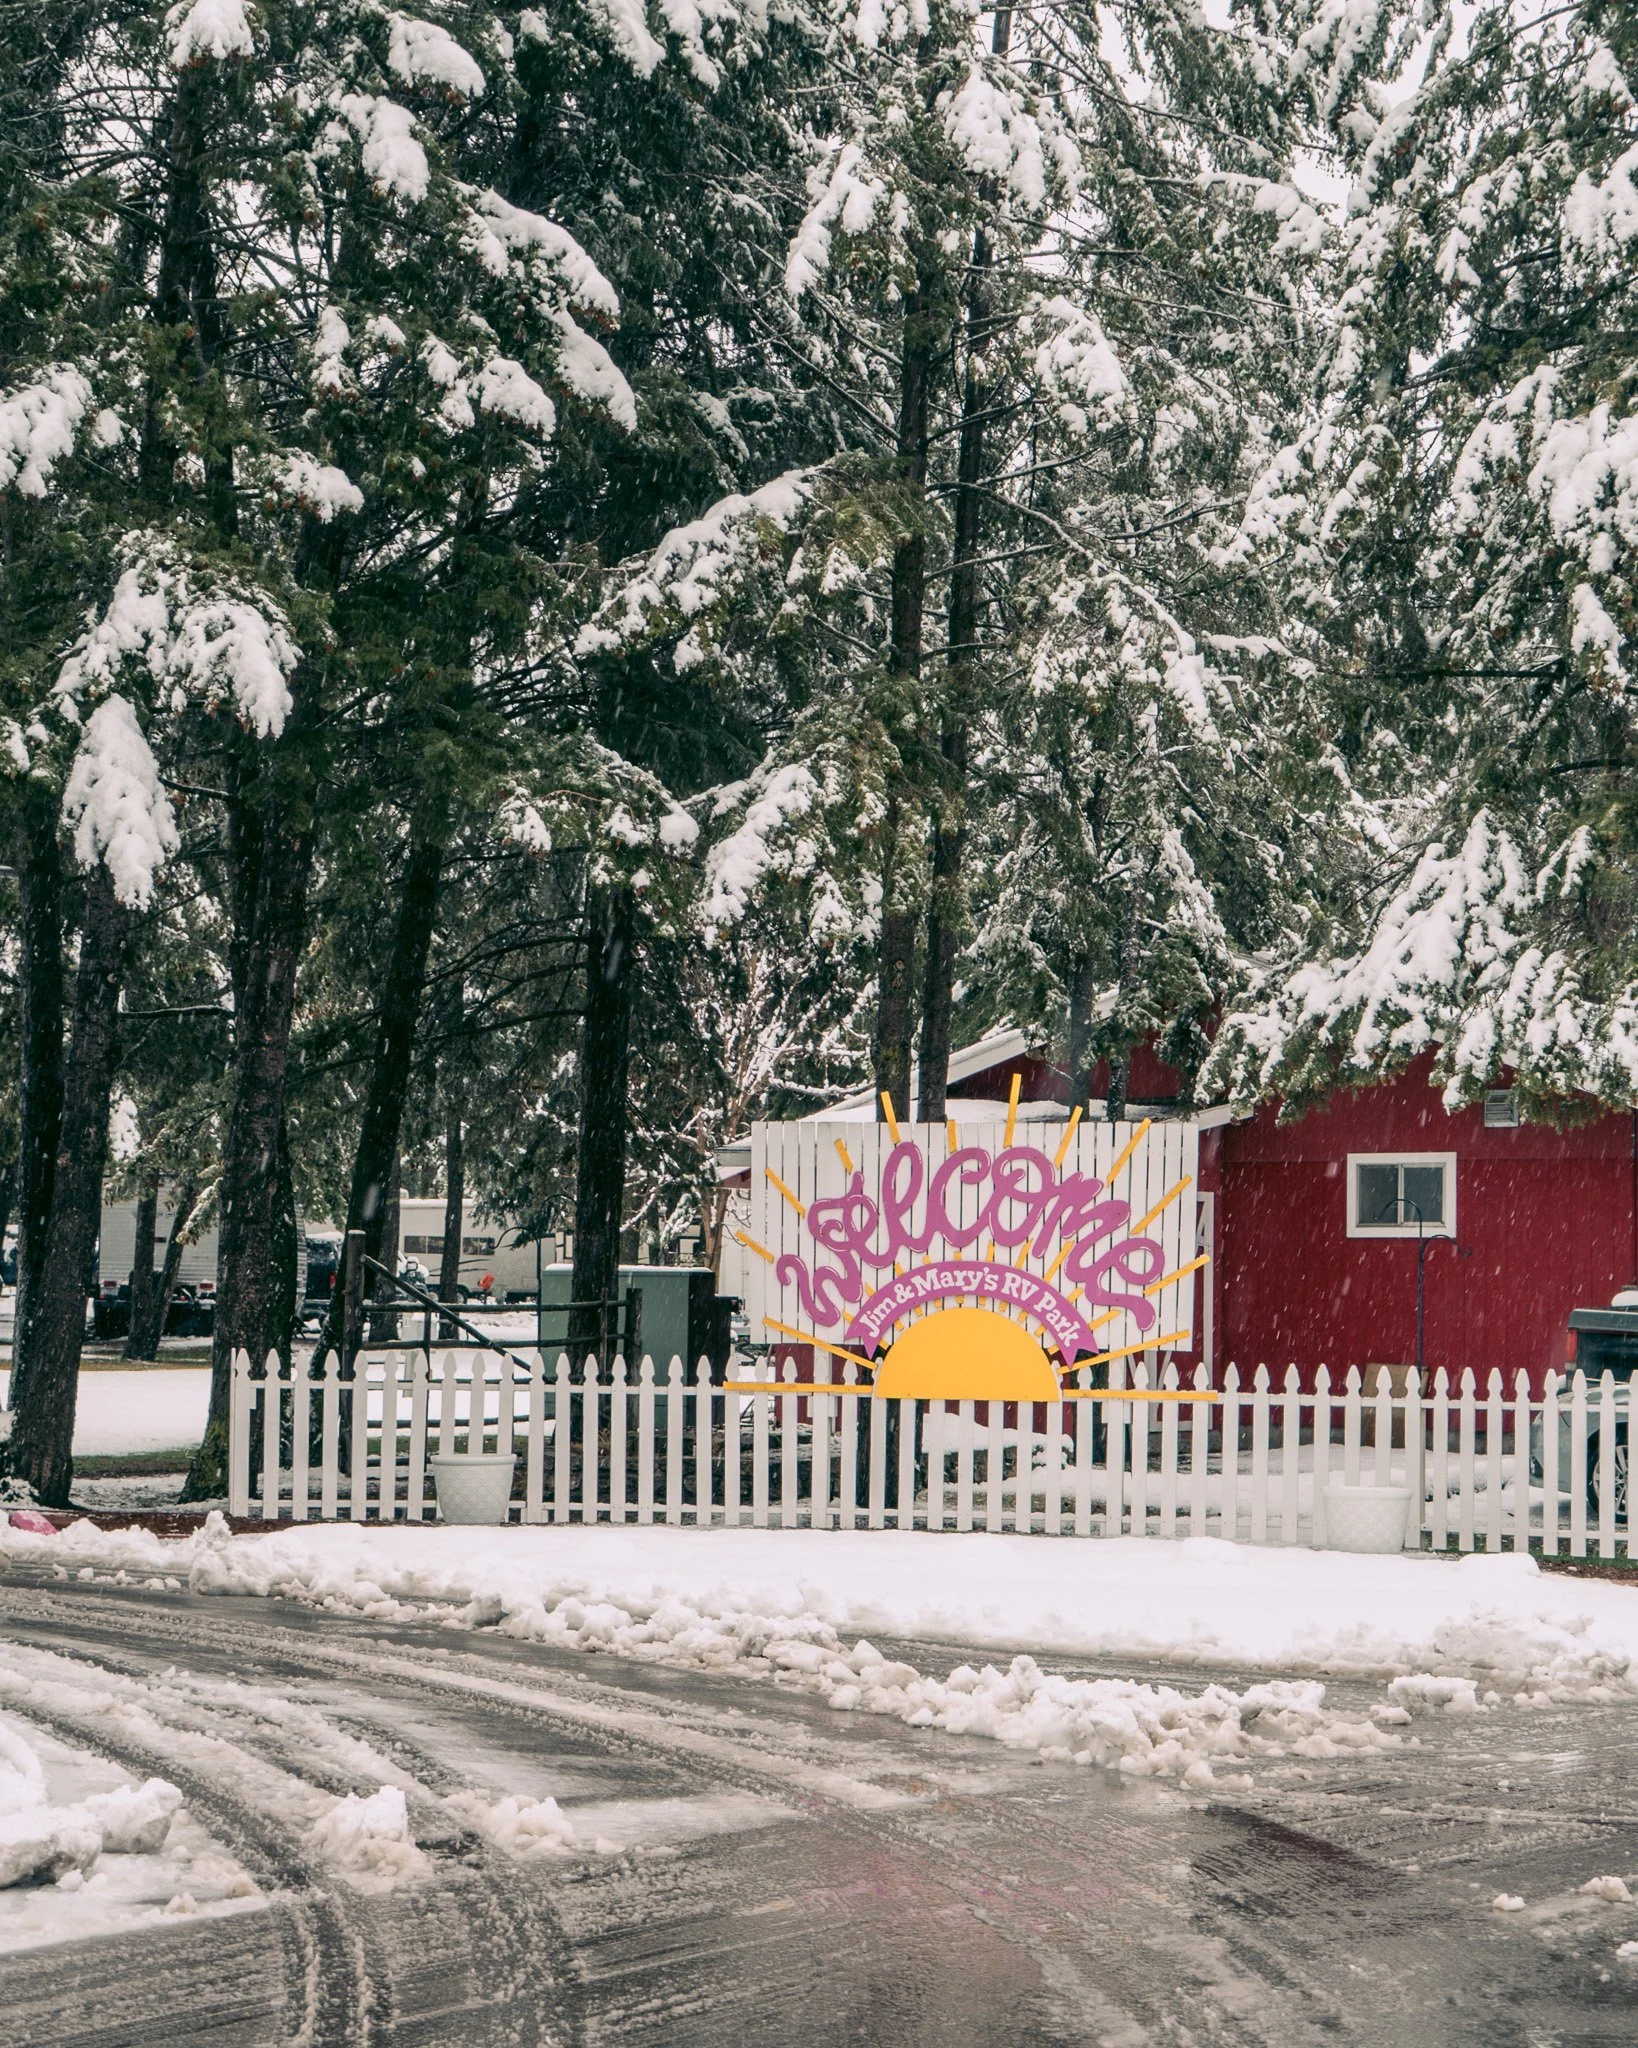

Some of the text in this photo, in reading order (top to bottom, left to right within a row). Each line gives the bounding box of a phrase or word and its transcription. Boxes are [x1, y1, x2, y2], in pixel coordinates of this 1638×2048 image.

[859, 1266, 1081, 1347] Jim & Mary's RV Park
